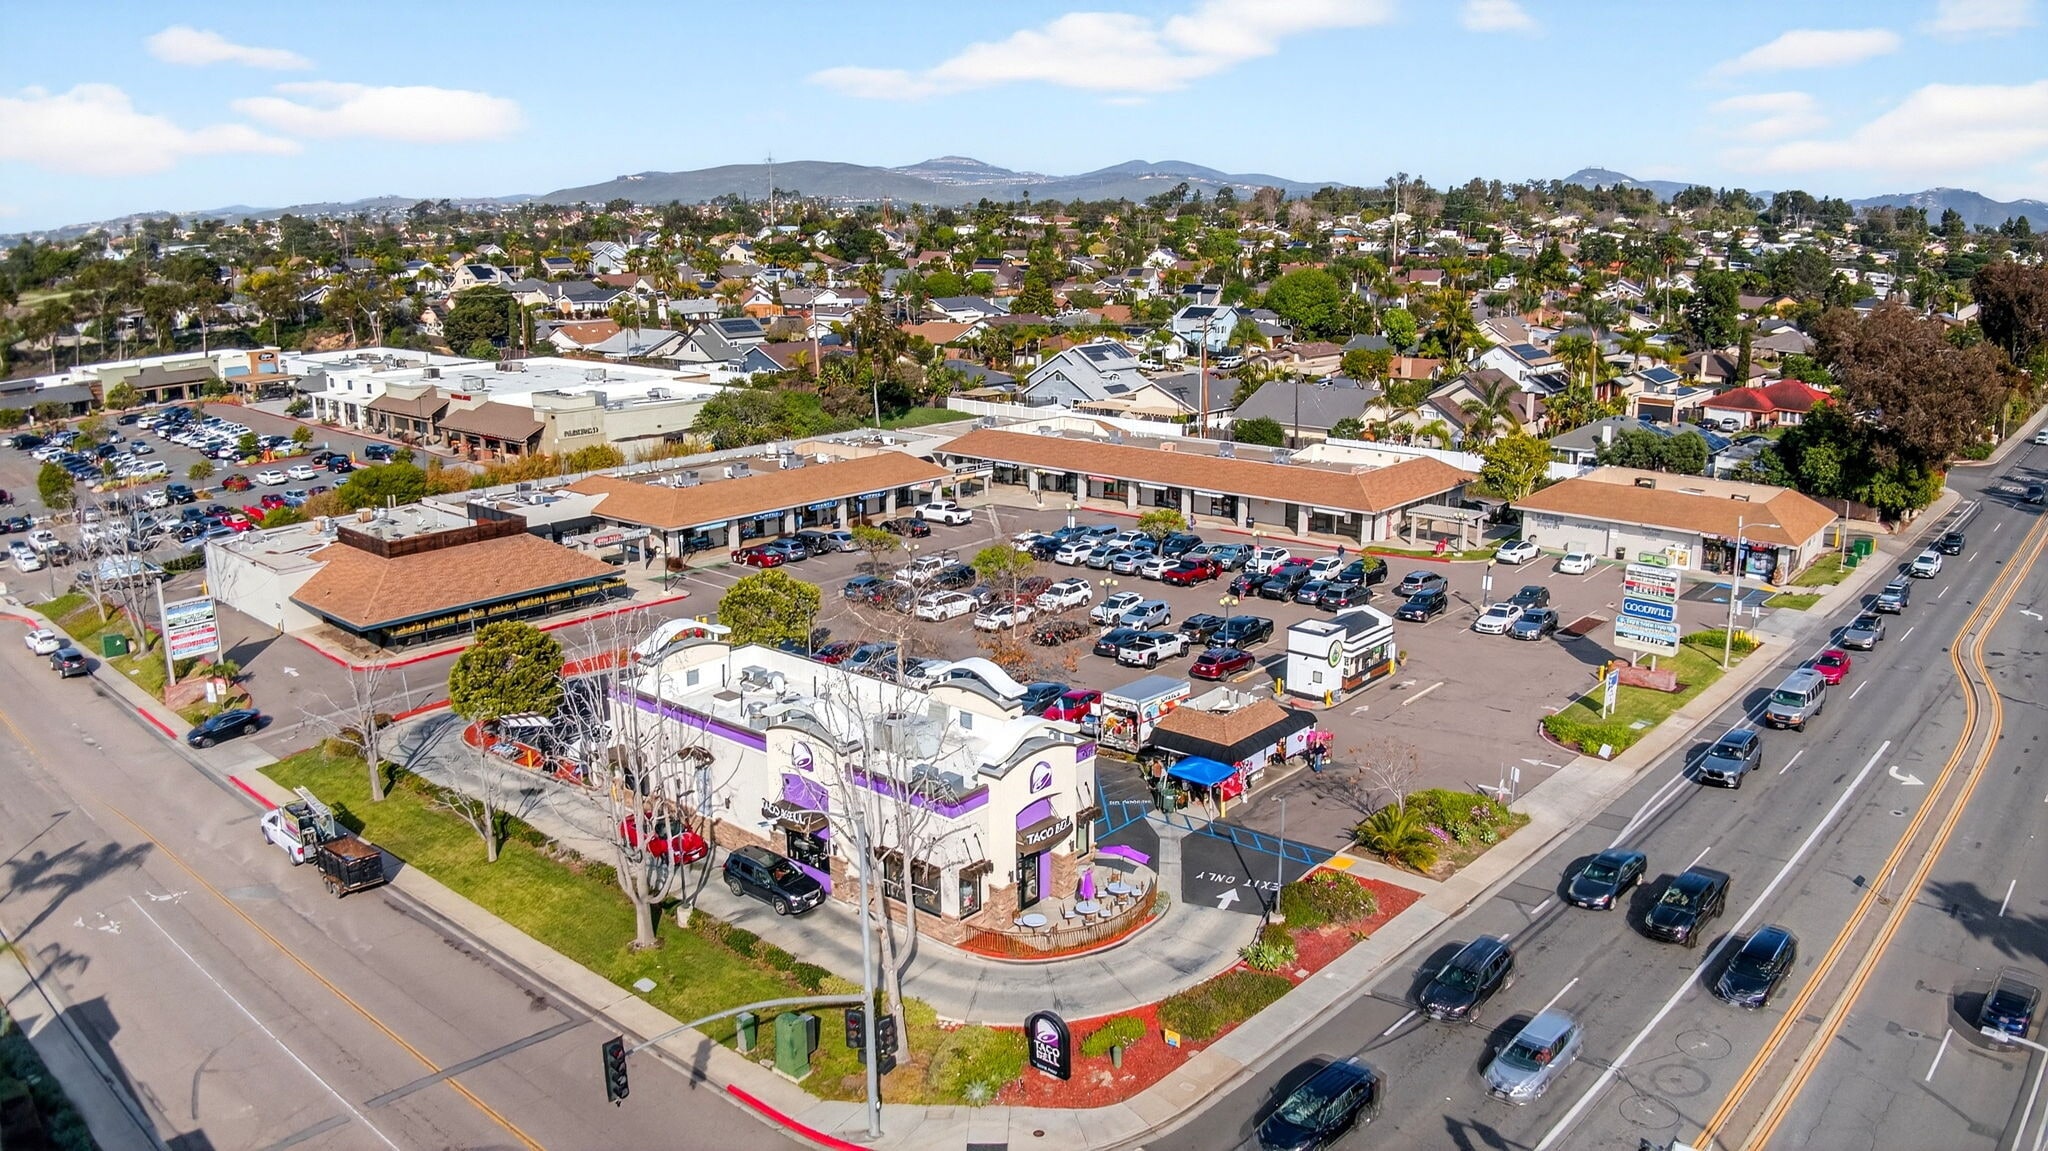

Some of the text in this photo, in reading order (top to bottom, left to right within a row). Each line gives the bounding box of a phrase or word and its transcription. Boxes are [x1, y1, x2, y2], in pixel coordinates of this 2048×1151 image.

[1624, 602, 1671, 618] GOODWILL
[1026, 827, 1054, 845] TACO
[1195, 871, 1283, 891] EXIT ONLY
[1033, 1039, 1060, 1058] TACO
[1036, 1049, 1060, 1068] BELL
